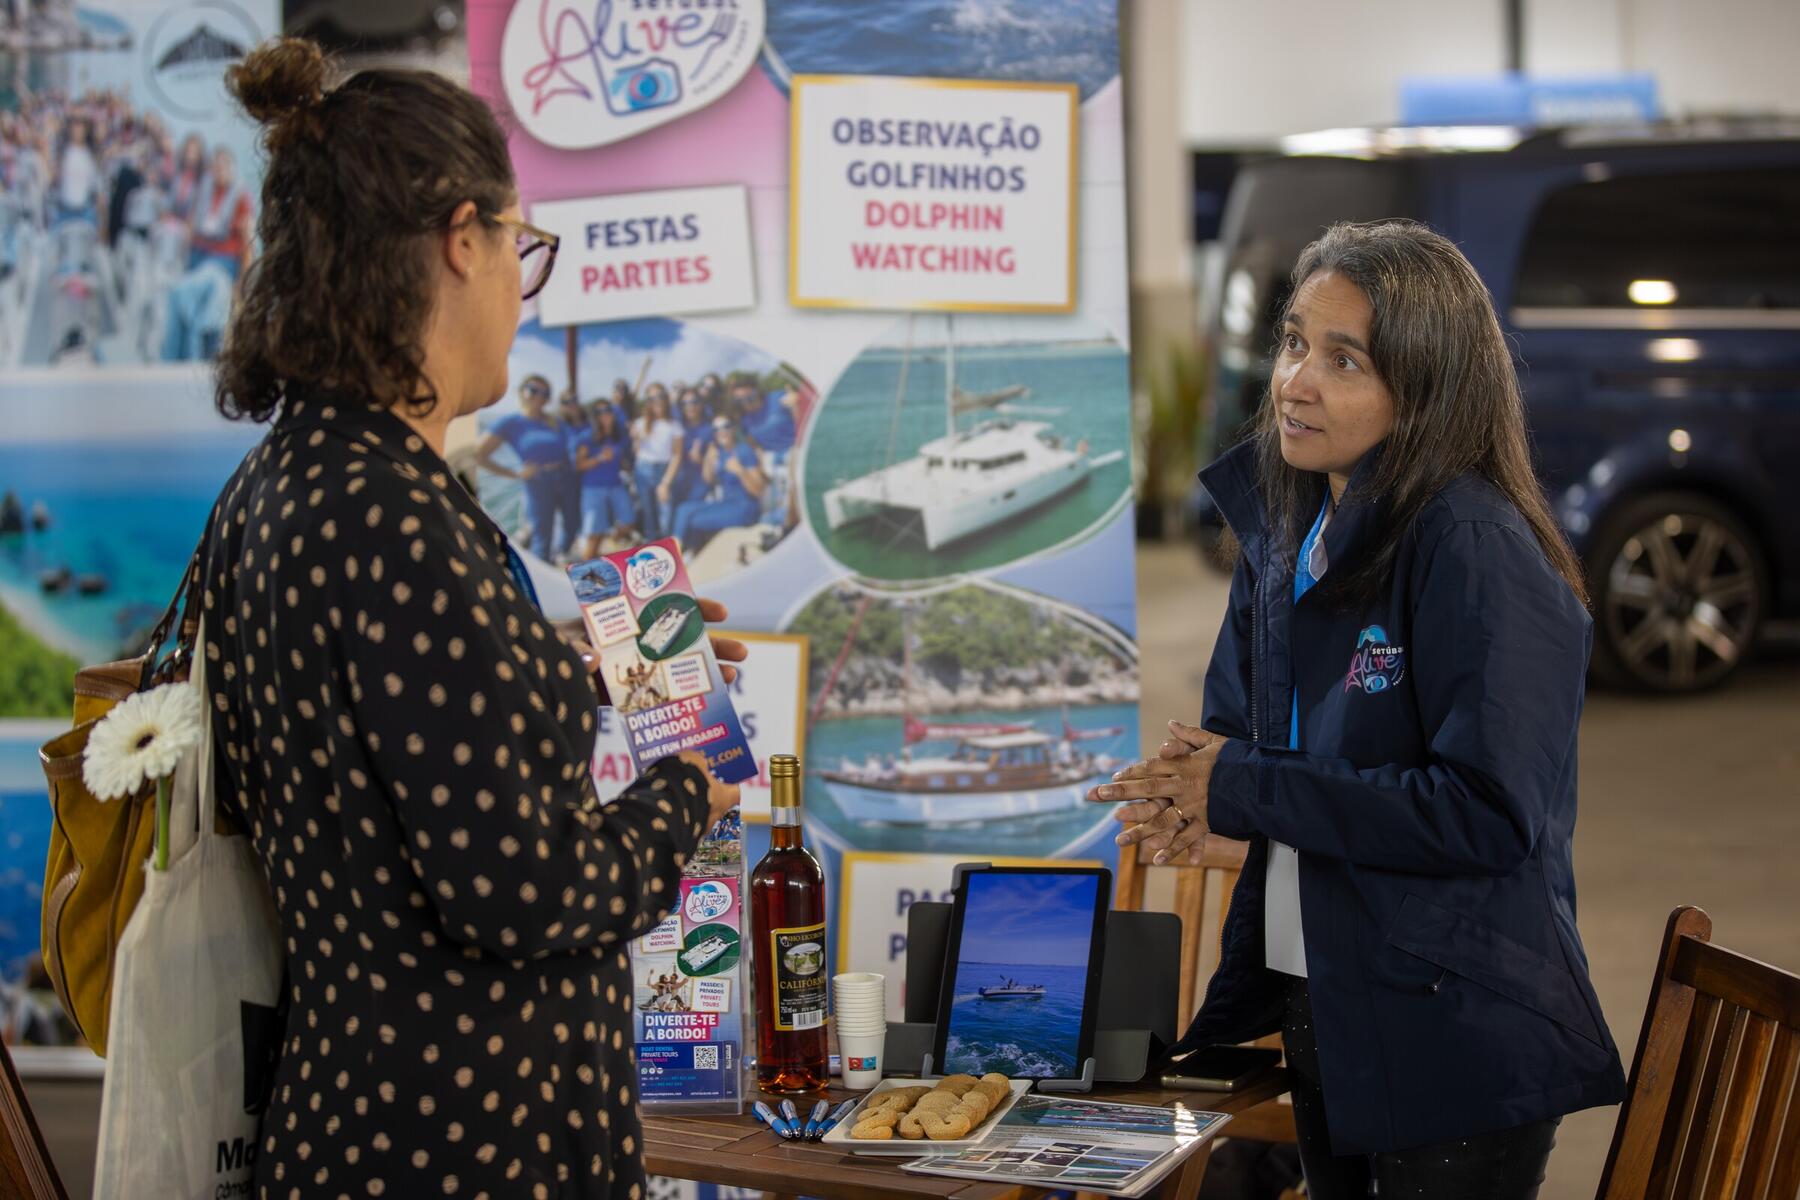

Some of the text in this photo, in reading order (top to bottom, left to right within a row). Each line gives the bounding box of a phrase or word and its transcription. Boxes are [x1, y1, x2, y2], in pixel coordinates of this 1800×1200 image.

[832, 116, 1041, 157] OBSERVAÇÃO
[847, 161, 1026, 193] GOLFINHOS
[585, 214, 700, 249] FESTAS
[865, 200, 1004, 231] DOLPHIN
[851, 242, 1017, 275] WATCHING
[581, 256, 711, 294] PARTIES
[1372, 646, 1404, 655] SETÚBA
[628, 696, 703, 730] DIVERTE-TE
[634, 715, 696, 746] A BORDO!
[645, 1014, 716, 1027] DIVERTE-TE
[645, 1028, 706, 1040] A BORDO!
